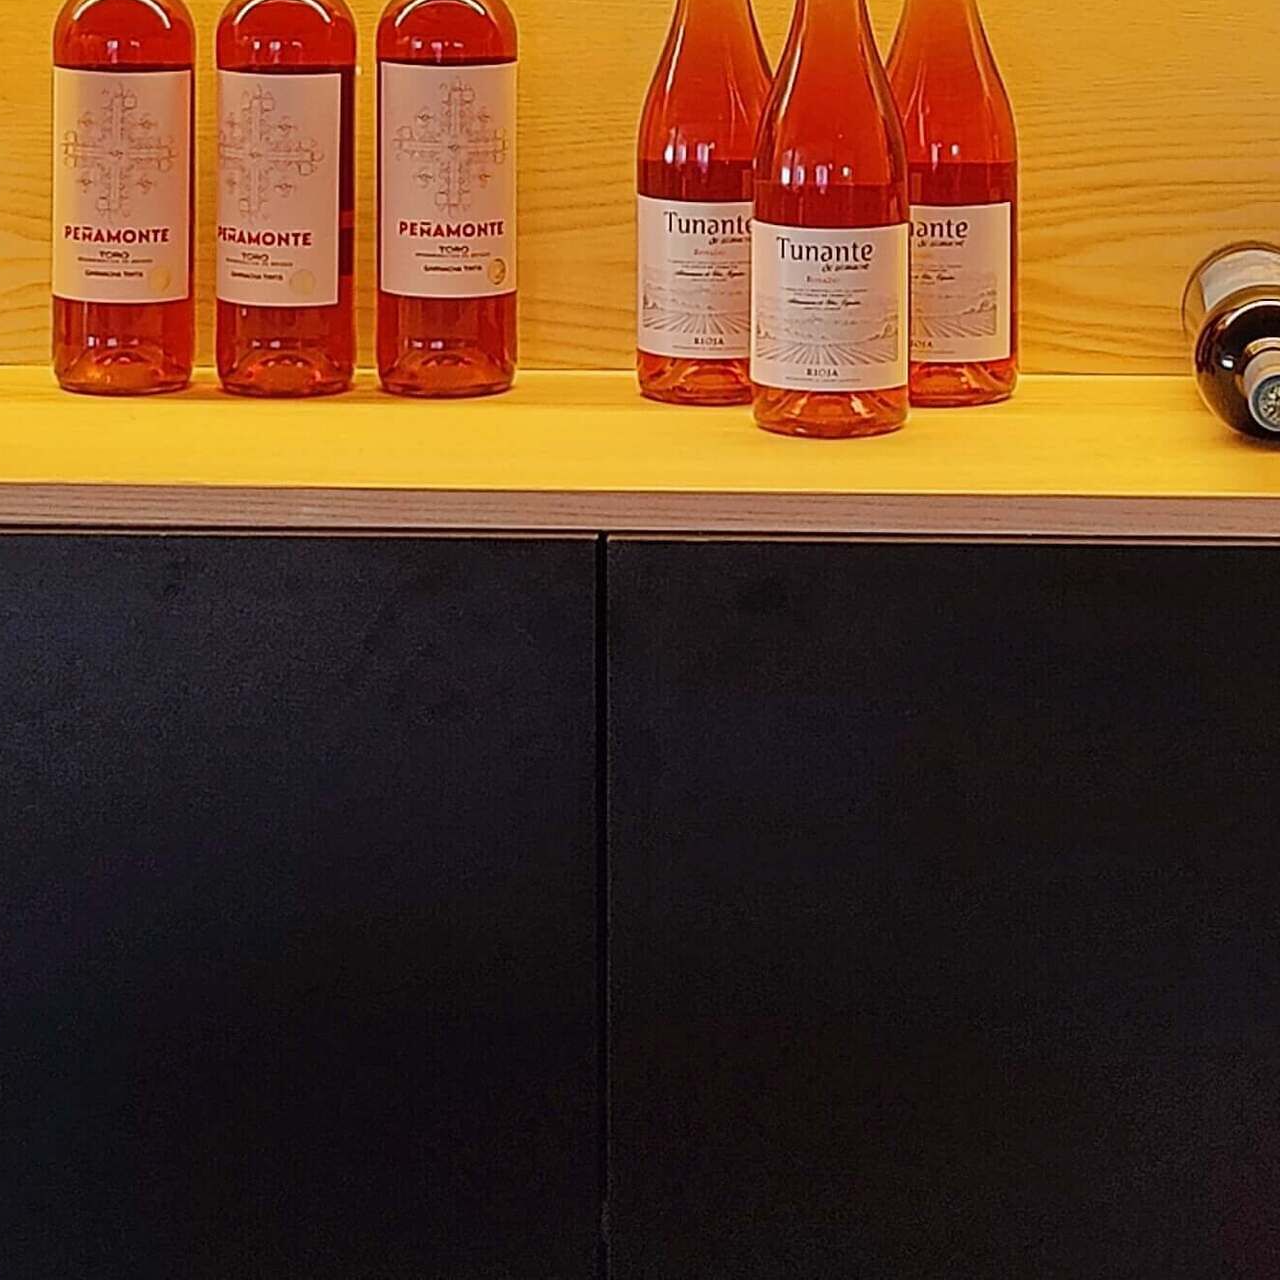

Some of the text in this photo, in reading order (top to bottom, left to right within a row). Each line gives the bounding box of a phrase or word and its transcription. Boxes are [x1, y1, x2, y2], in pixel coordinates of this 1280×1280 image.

[64, 225, 170, 244] PEÑAMONTE
[399, 220, 504, 238] PEÑAMONTE
[776, 236, 873, 262] Tunante
